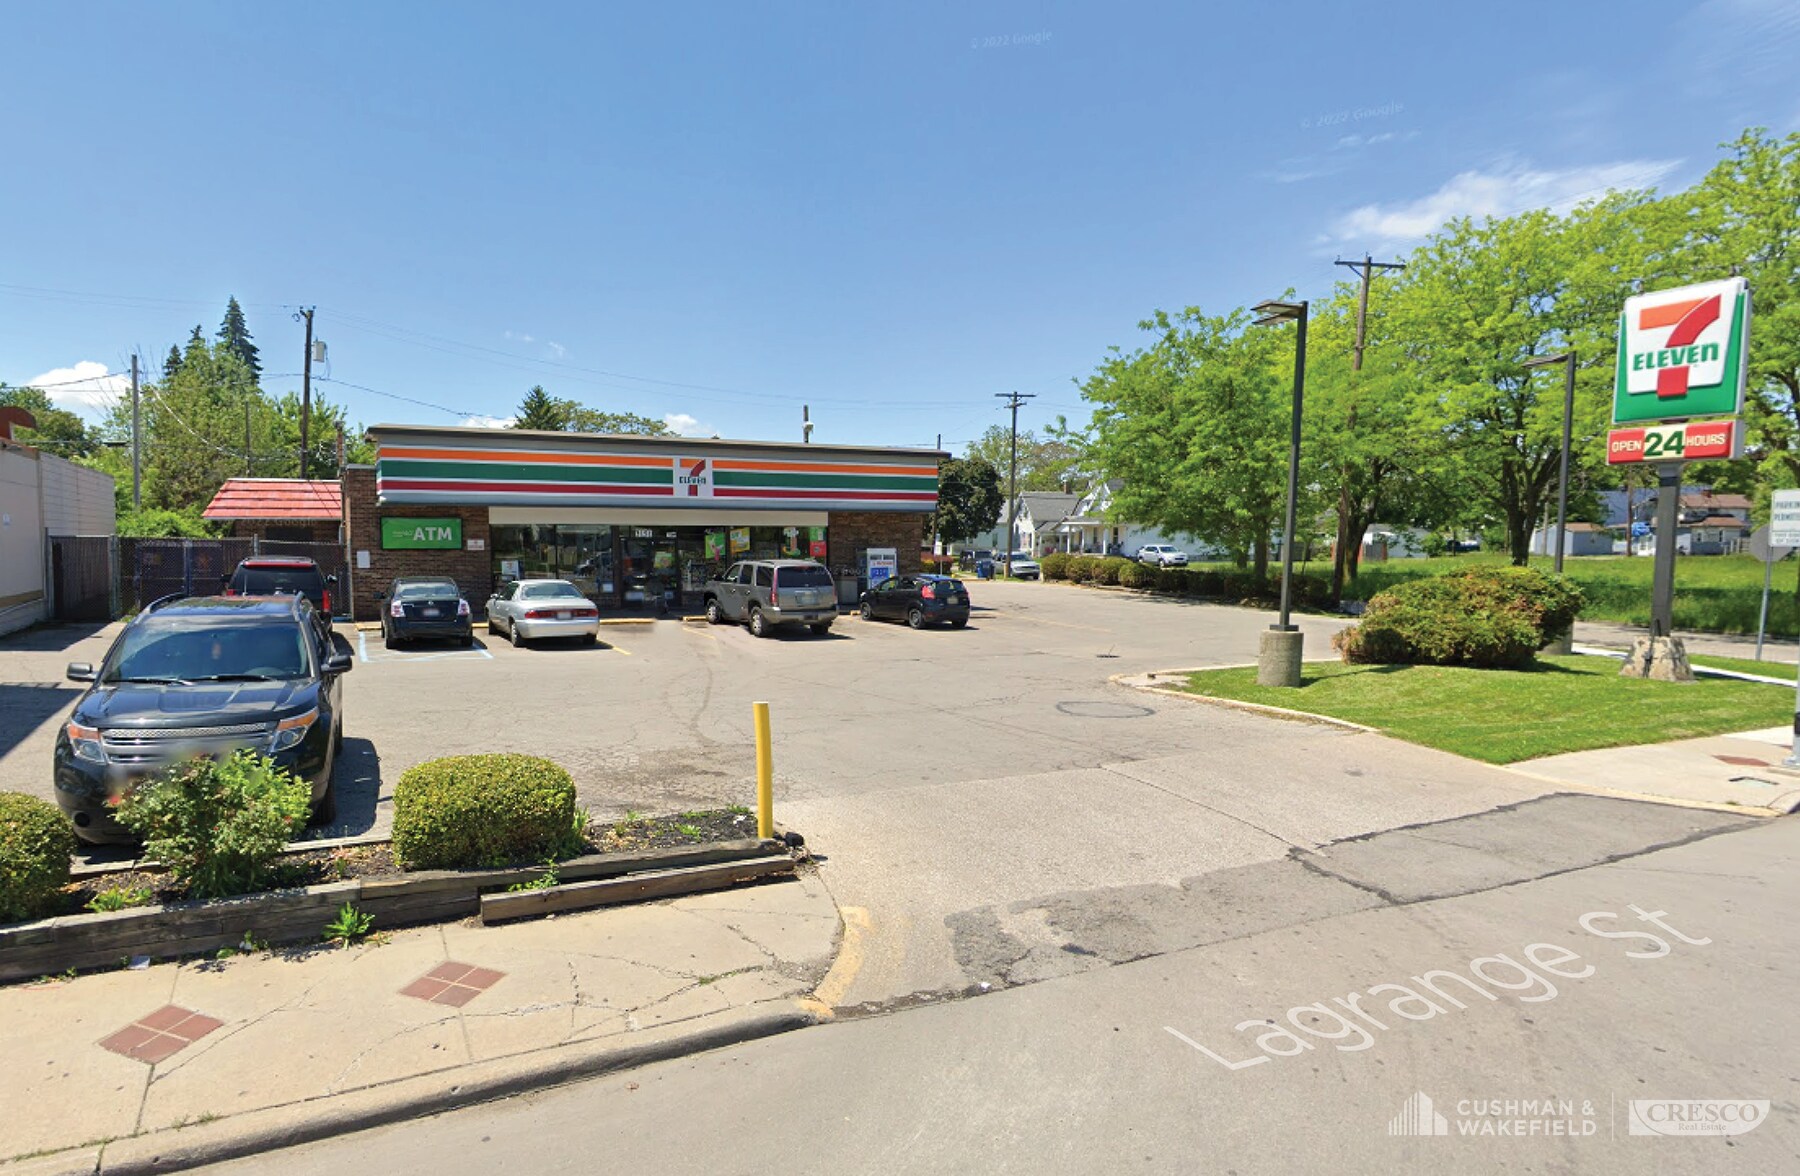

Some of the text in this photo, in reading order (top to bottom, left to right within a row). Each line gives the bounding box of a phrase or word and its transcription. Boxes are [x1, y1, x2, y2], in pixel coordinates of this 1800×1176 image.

[1639, 294, 1721, 398] 7
[1611, 430, 1726, 456] OPEN 24 HOURS
[680, 459, 706, 497] 7
[413, 525, 453, 541] ATM
